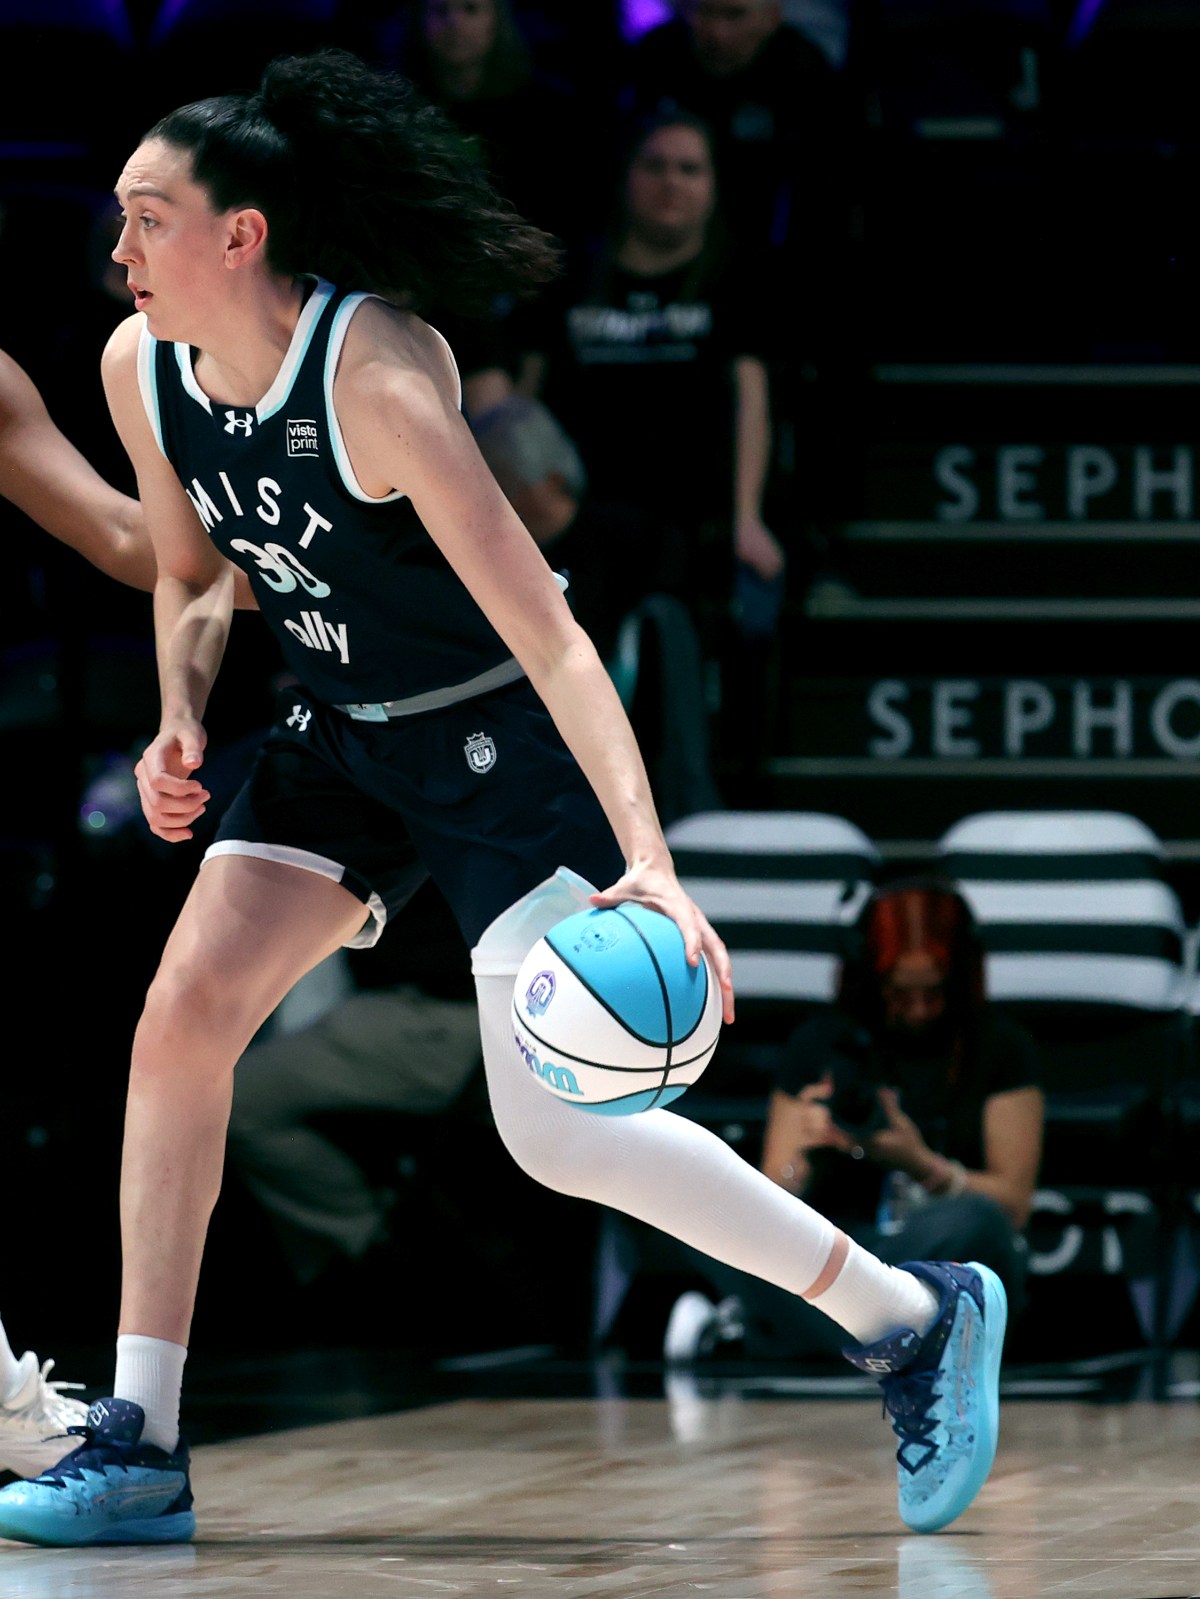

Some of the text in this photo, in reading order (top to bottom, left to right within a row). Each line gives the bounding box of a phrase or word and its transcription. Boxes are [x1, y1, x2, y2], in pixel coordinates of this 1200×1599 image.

[289, 424, 317, 437] vista
[291, 436, 319, 452] print
[932, 442, 1196, 521] SEPH
[186, 471, 333, 550] MIST
[230, 538, 331, 599] 30
[284, 611, 350, 664] ally
